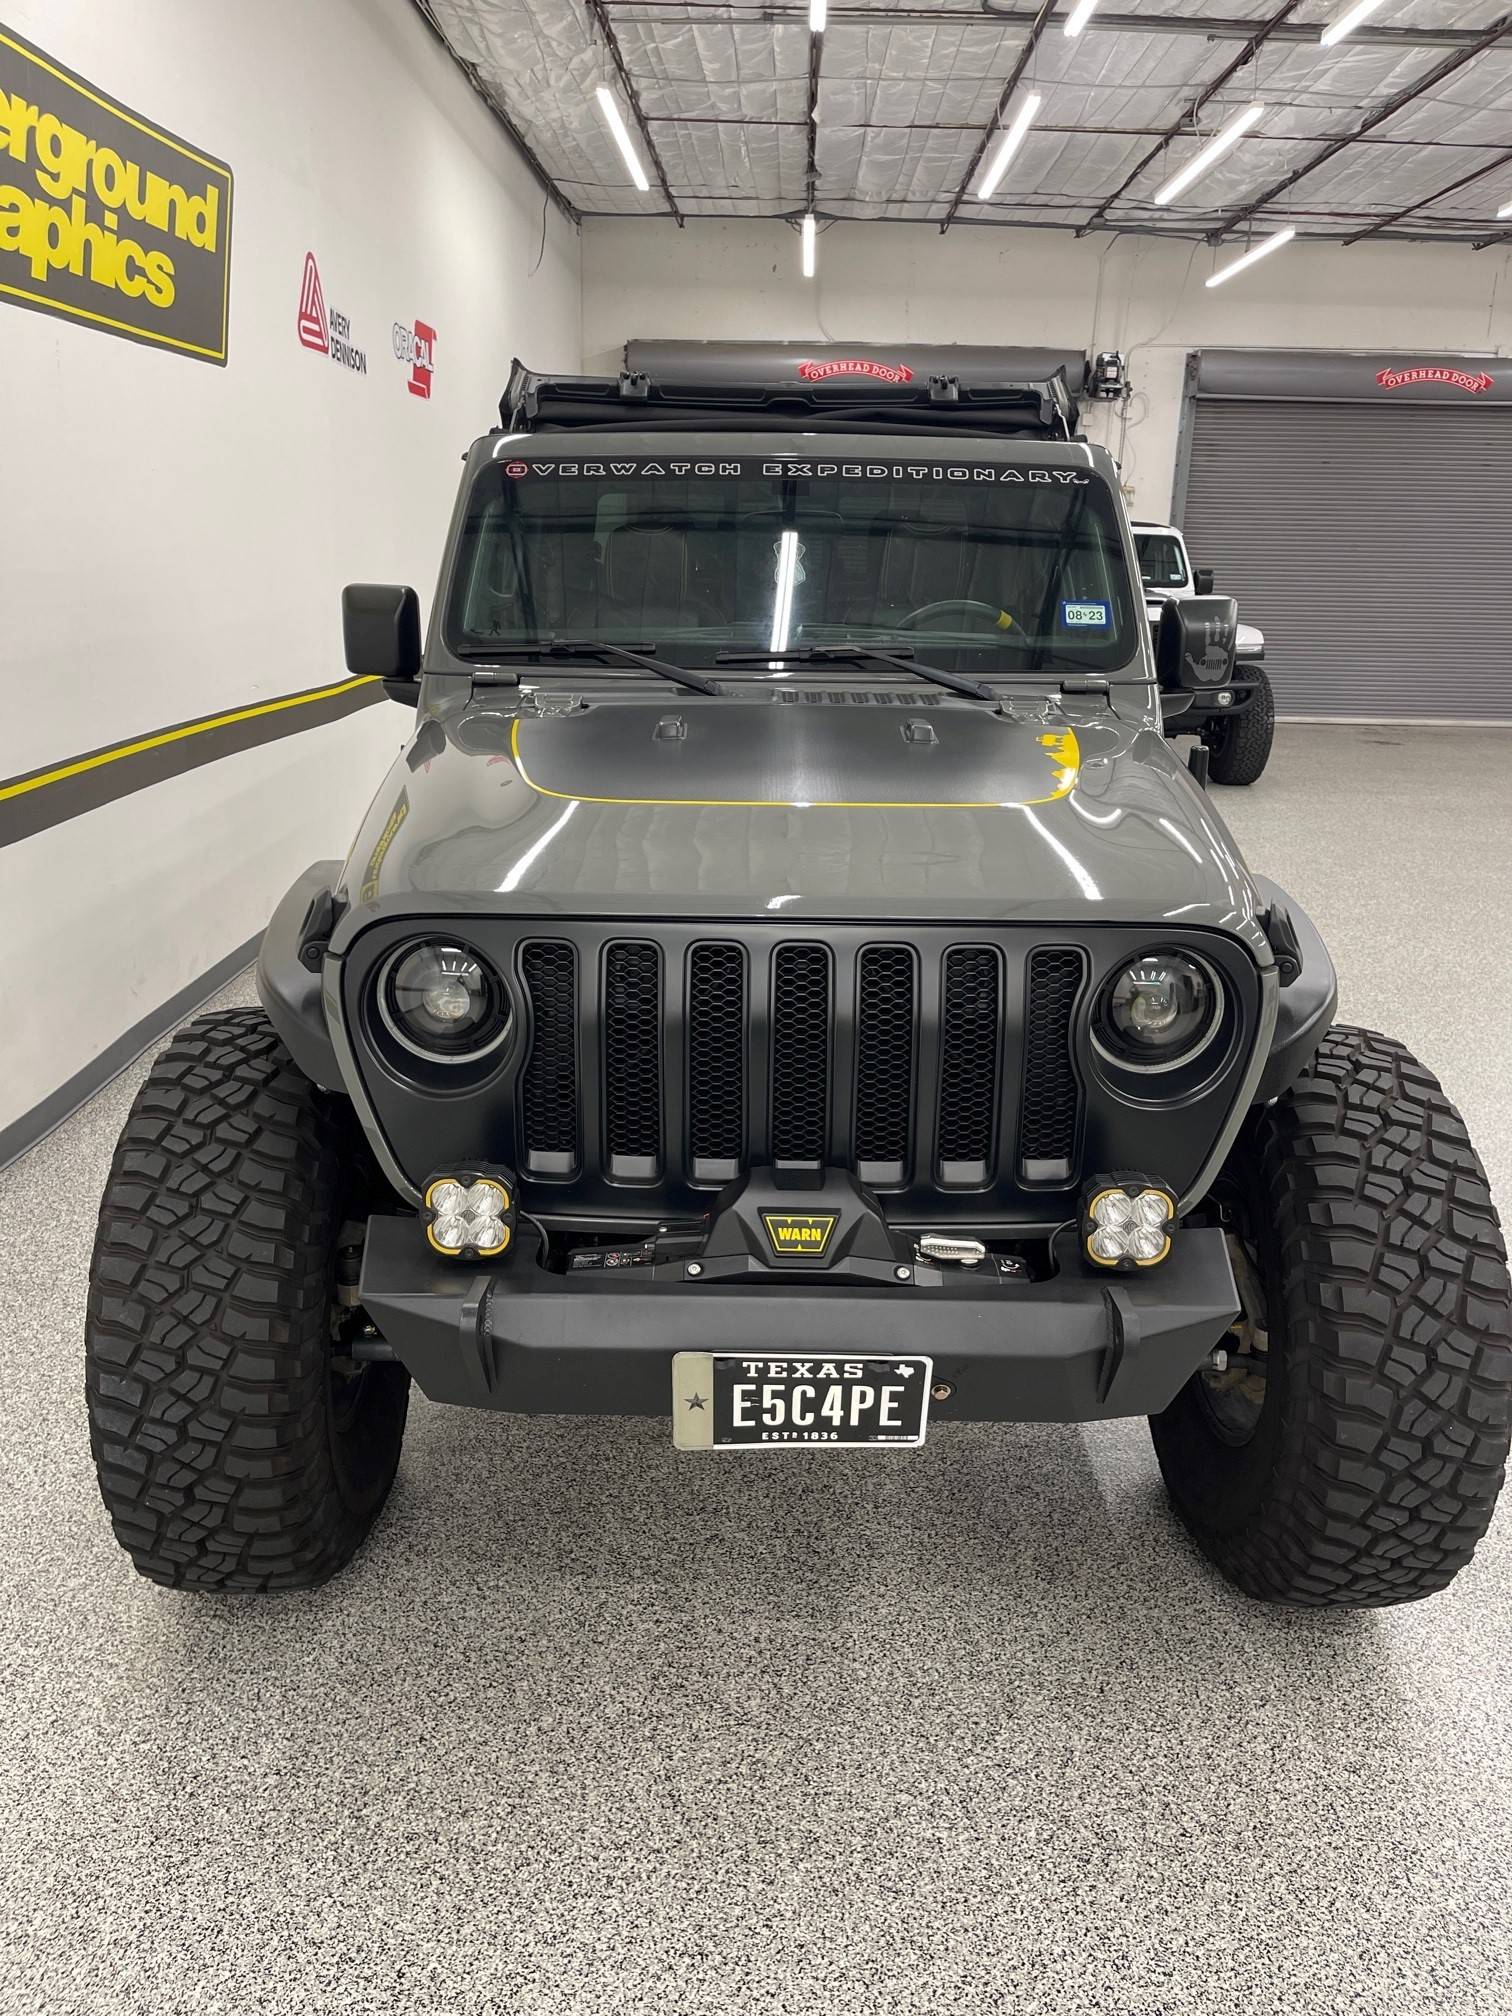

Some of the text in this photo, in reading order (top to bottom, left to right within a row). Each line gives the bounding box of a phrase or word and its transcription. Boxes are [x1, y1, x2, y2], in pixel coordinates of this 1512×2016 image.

[330, 308, 351, 340] AVERY
[330, 336, 367, 375] DENNISON
[392, 322, 434, 373] ORACAL
[810, 362, 900, 383] OVERHEAD DOOR
[1387, 369, 1479, 391] OVERHEAD DOOR
[506, 462, 1076, 484] OVERWATCH EXPEDITIONARY
[1067, 610, 1103, 621] 08 23
[778, 1227, 822, 1241] WARN
[742, 1361, 864, 1379] TEXAS
[732, 1384, 905, 1427] E5C4PE
[802, 1431, 839, 1441] 1836
